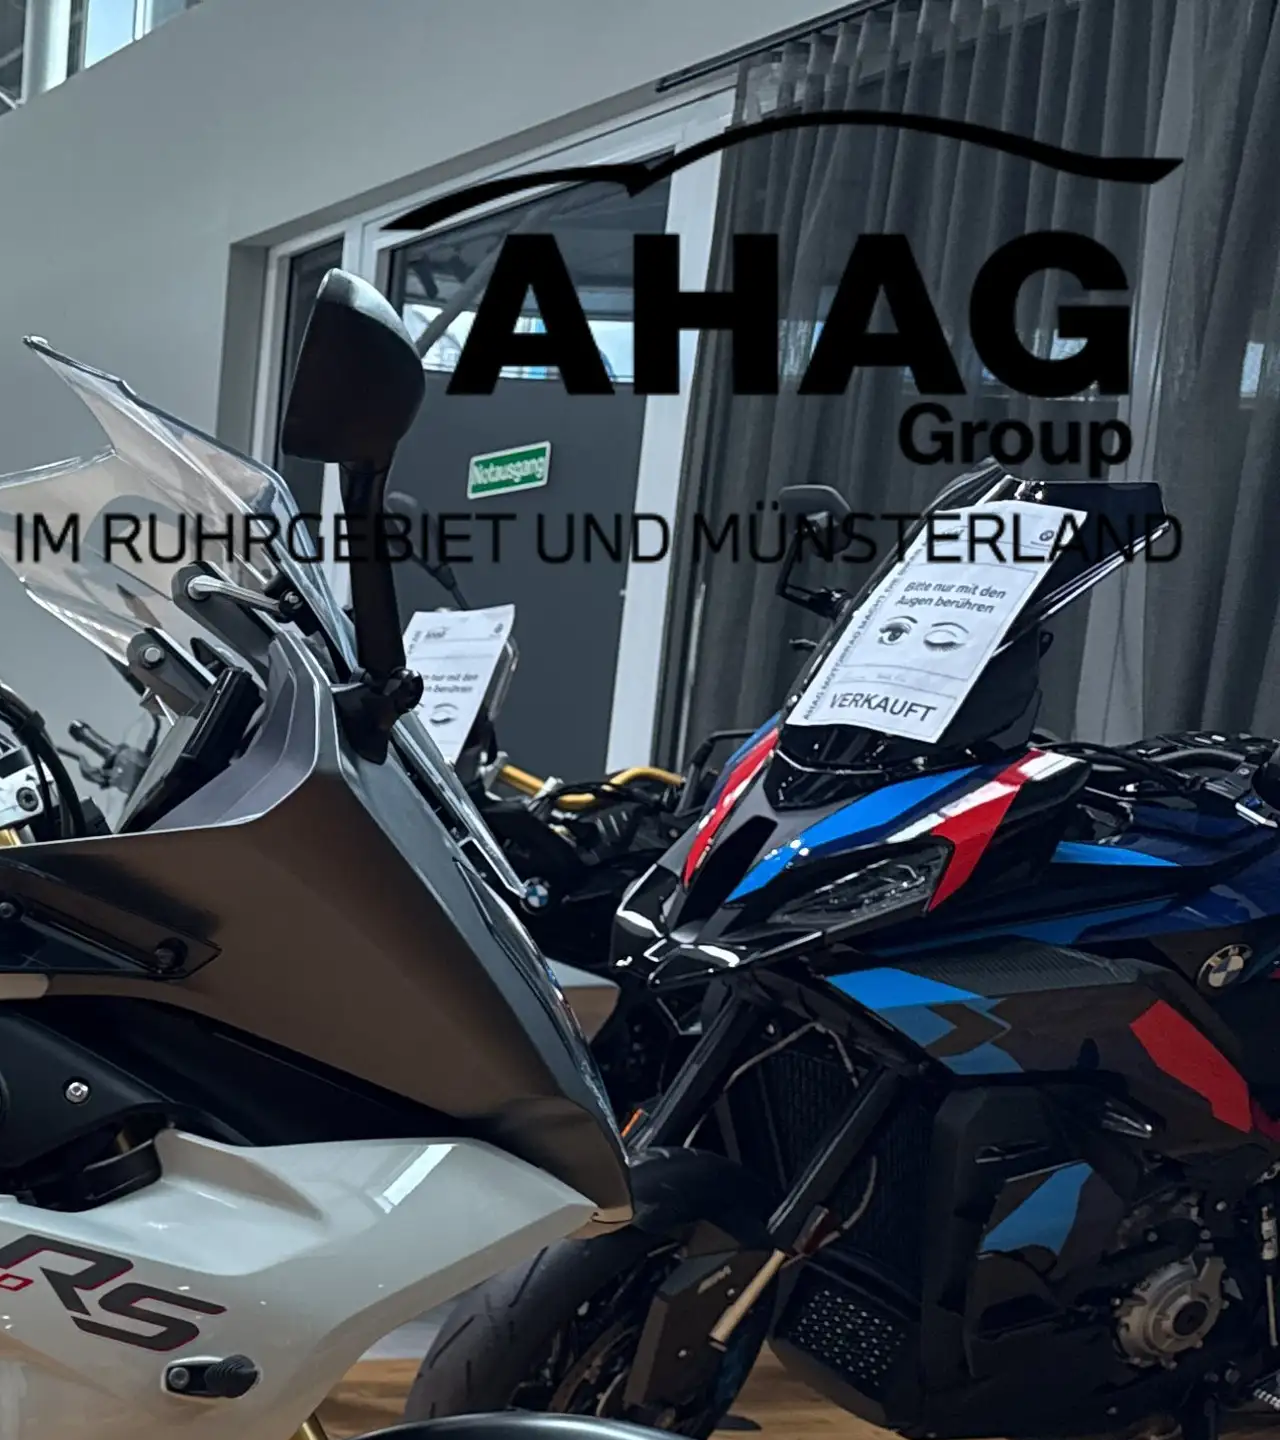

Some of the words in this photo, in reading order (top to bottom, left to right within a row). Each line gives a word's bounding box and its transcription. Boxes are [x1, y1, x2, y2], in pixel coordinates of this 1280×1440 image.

[470, 456, 546, 485] Notausgang
[903, 580, 933, 593] Bitte
[933, 583, 956, 593] nur
[955, 583, 979, 596] mit
[980, 585, 1007, 600] den
[934, 596, 996, 615] berühren
[829, 692, 938, 723] VERKAUFT
